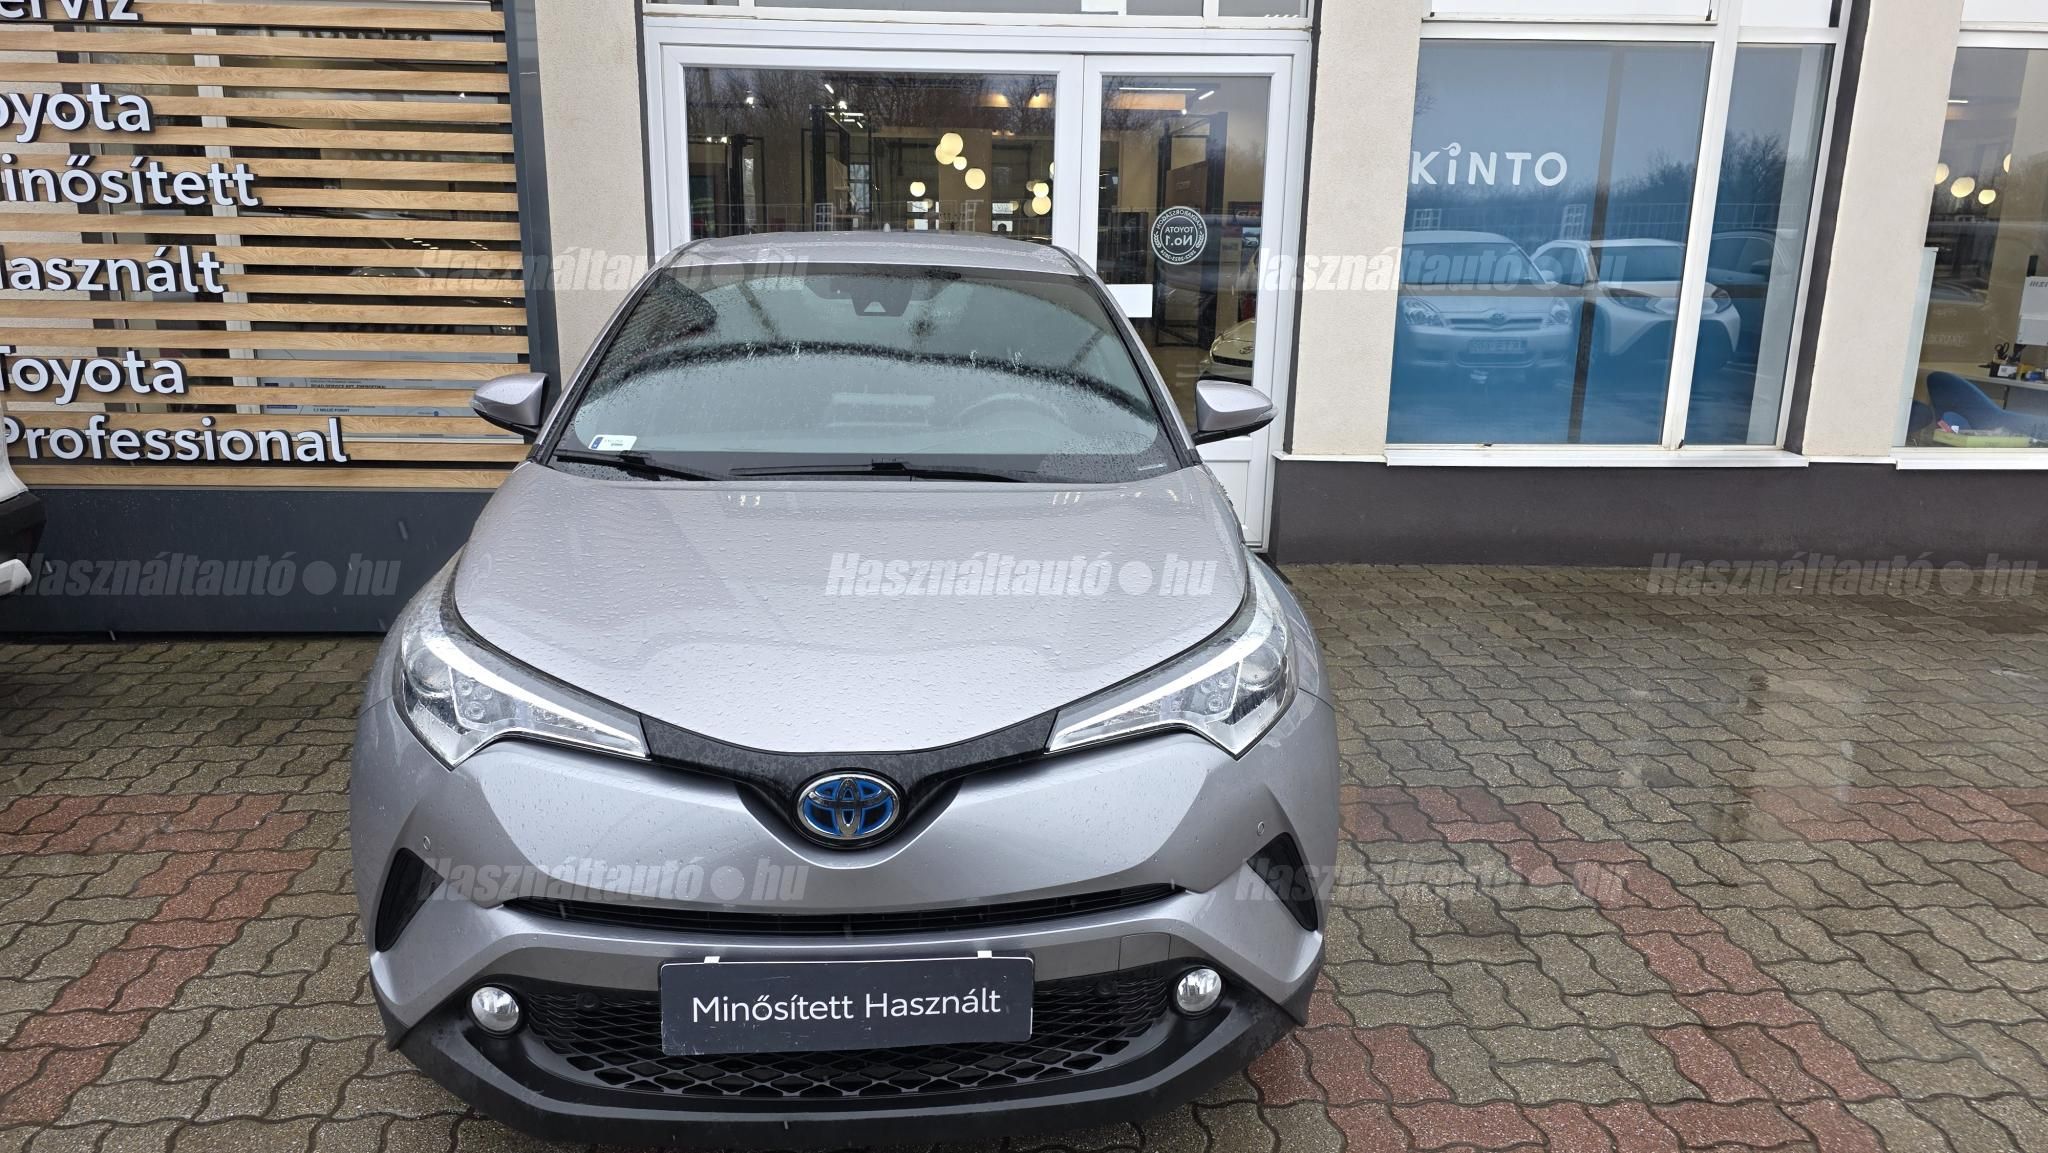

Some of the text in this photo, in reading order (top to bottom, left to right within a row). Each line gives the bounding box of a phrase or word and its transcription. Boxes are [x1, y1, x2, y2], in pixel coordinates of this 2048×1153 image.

[0, 83, 151, 143] yota
[0, 245, 225, 294] asznált
[3, 414, 348, 463] Professional
[692, 987, 1001, 1023] Minősített Használt
